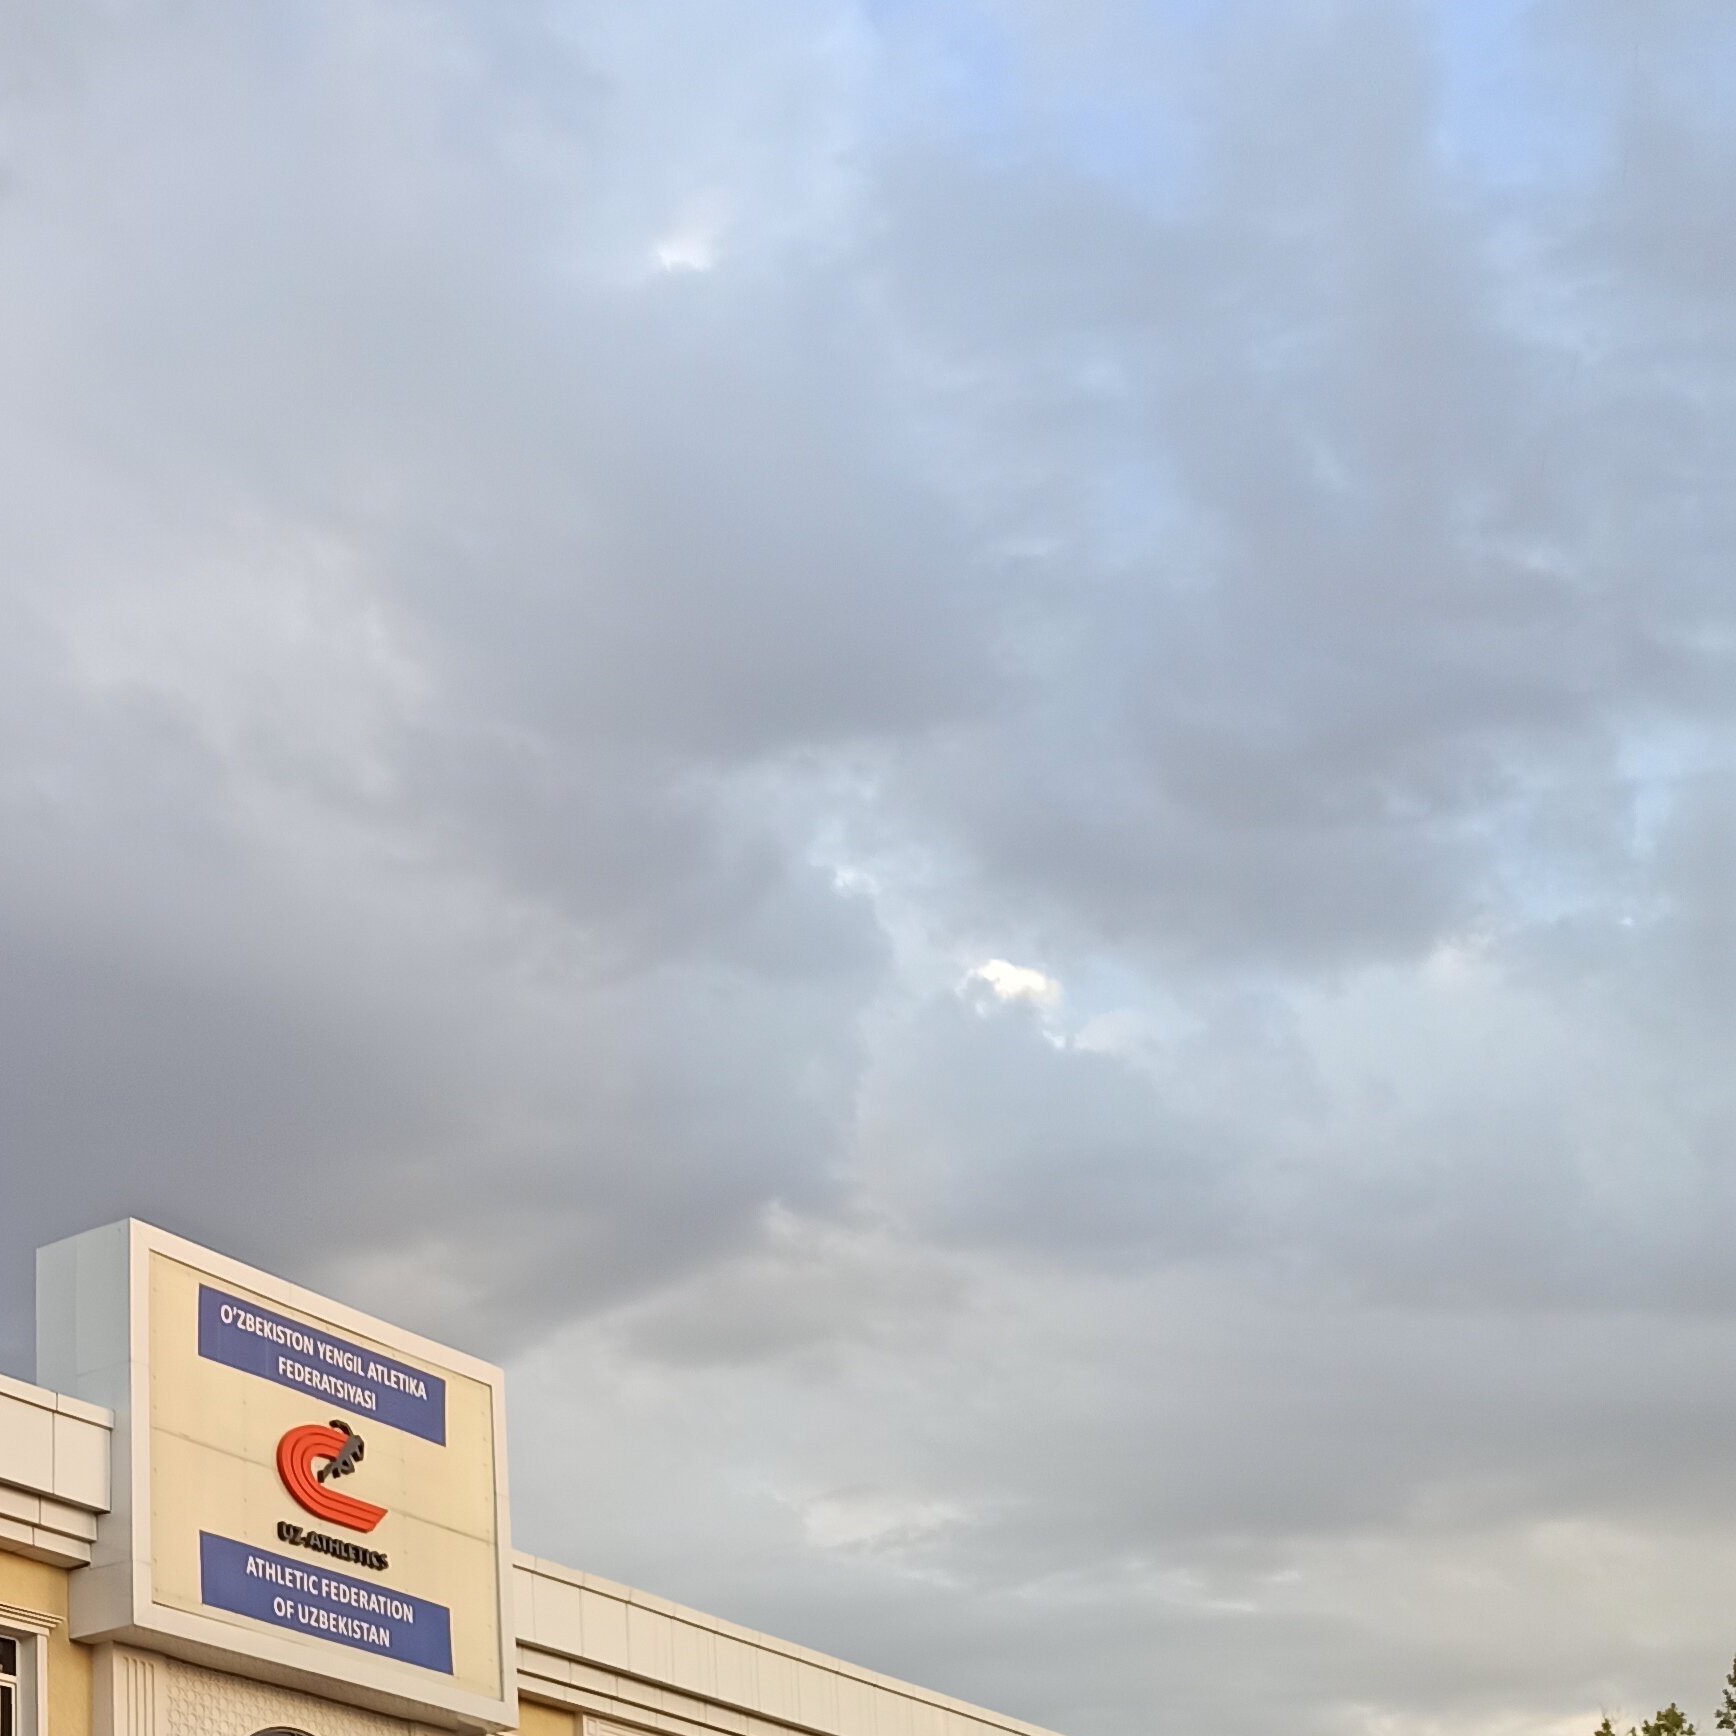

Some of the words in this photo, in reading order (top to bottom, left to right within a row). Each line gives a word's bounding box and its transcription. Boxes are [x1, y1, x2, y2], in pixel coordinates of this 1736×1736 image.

[220, 1304, 313, 1355] O'ZBEKISTON
[317, 1343, 365, 1376] YENGIL
[367, 1362, 427, 1400] ATLETIKA
[278, 1357, 376, 1410] FEDERATSIYASI
[277, 1521, 389, 1570] UZ-ATHLETICS
[246, 1556, 318, 1595] ATHLETIC
[321, 1579, 413, 1623] FEDERATION
[273, 1597, 295, 1618] OF
[298, 1605, 390, 1647] UZBEKISTAN
